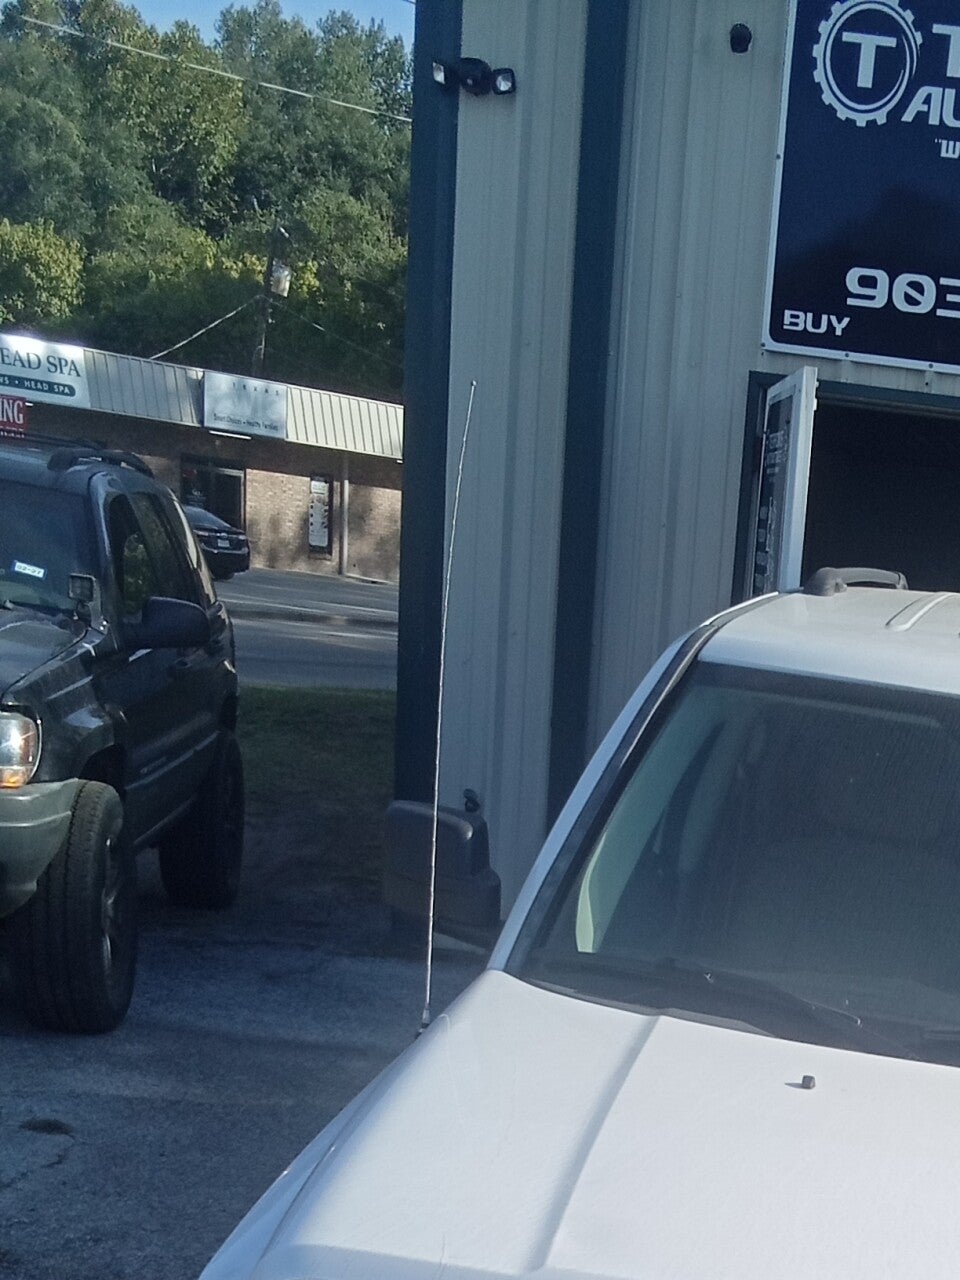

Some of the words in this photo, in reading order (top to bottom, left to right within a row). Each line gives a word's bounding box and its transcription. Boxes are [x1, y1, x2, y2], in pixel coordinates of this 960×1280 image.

[842, 32, 897, 89] T
[783, 309, 851, 336] BUY
[46, 355, 81, 377] SPA
[24, 380, 49, 391] HEAD
[54, 384, 70, 394] SPA
